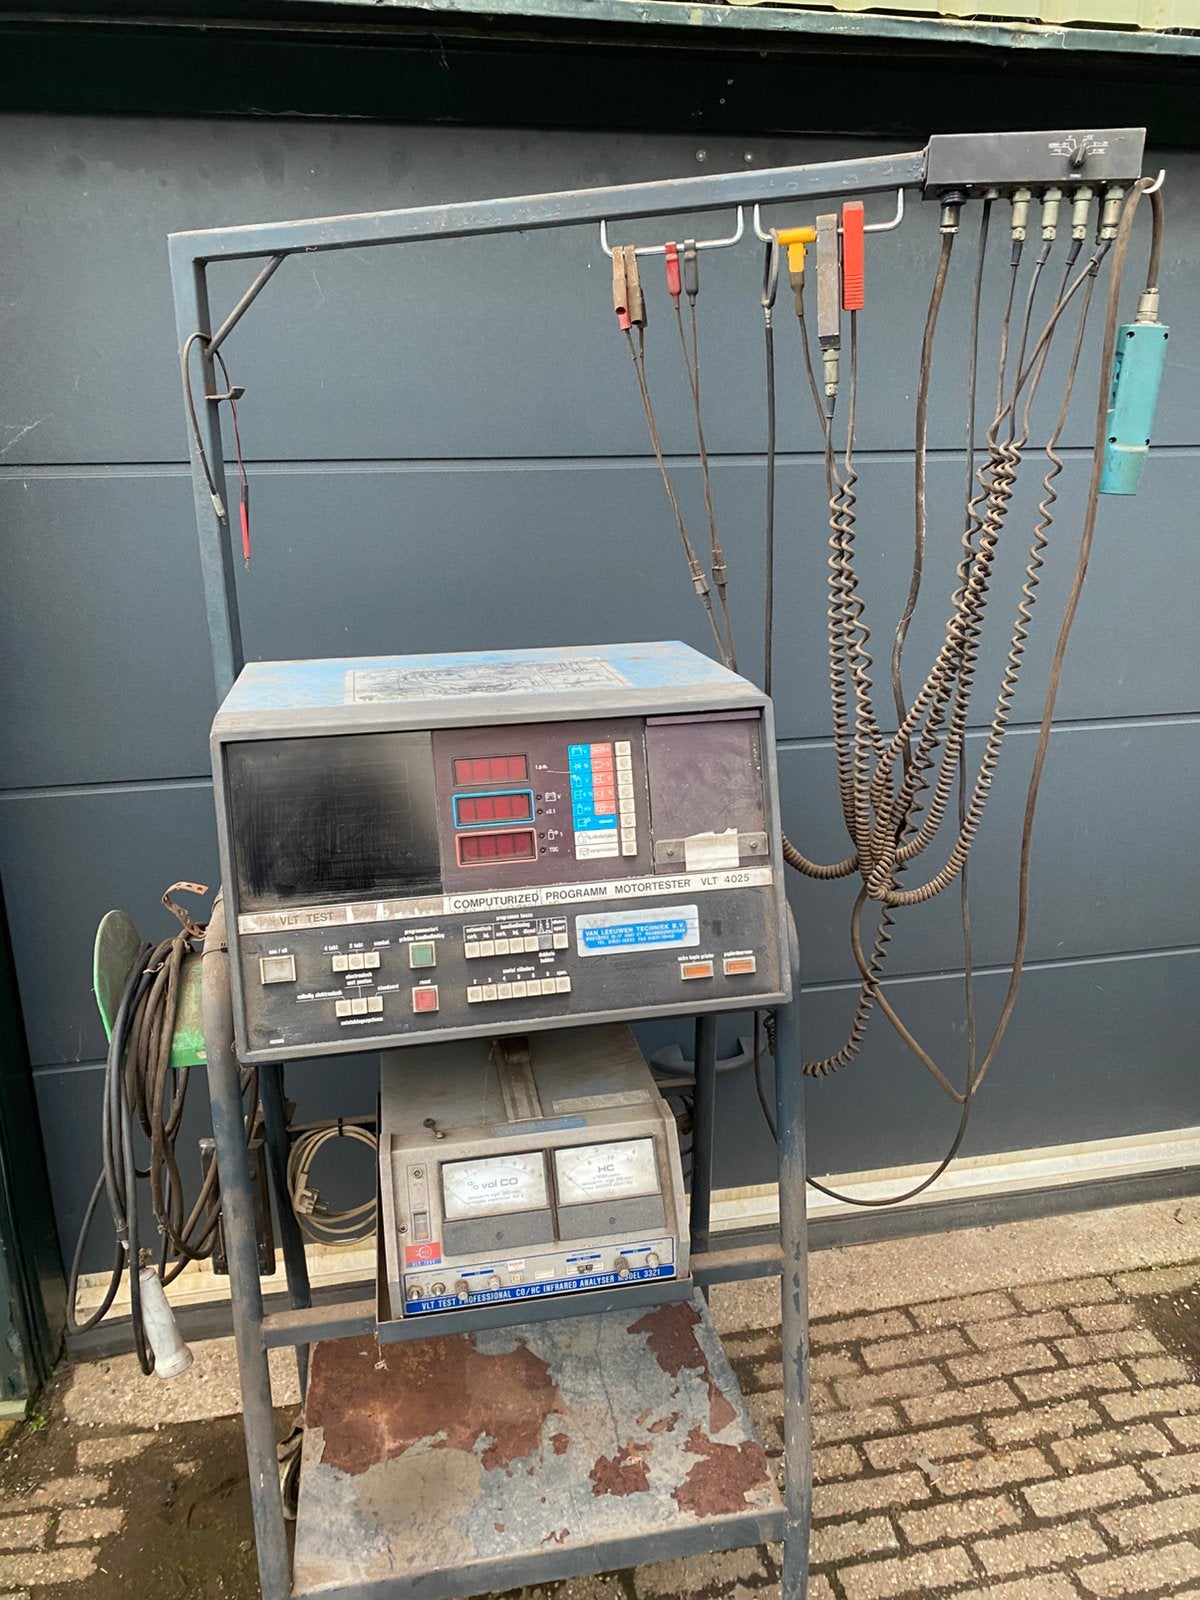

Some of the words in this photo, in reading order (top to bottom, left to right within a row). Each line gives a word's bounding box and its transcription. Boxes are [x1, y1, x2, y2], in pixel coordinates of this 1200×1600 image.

[453, 893, 539, 909] COMPUTURIZED
[545, 886, 607, 900] PROGRAMM
[614, 879, 691, 894] MOTORTESTER
[700, 876, 718, 886] VLT
[724, 873, 750, 883] 4025
[280, 915, 299, 926] VLT
[306, 912, 334, 923] TEST
[601, 927, 633, 936] LEEUWEN
[636, 924, 669, 932] TECHNIEK
[597, 1164, 615, 1173] HC
[481, 1180, 497, 1189] vol
[500, 1177, 518, 1186] CO
[421, 1301, 434, 1311] VLT
[438, 1298, 456, 1308] TEST
[515, 1285, 540, 1297] CO/HC
[543, 1281, 577, 1292] INFRARED
[580, 1275, 615, 1287] ANALYSER
[618, 1270, 641, 1281] DEL
[643, 1269, 661, 1278] 3321
